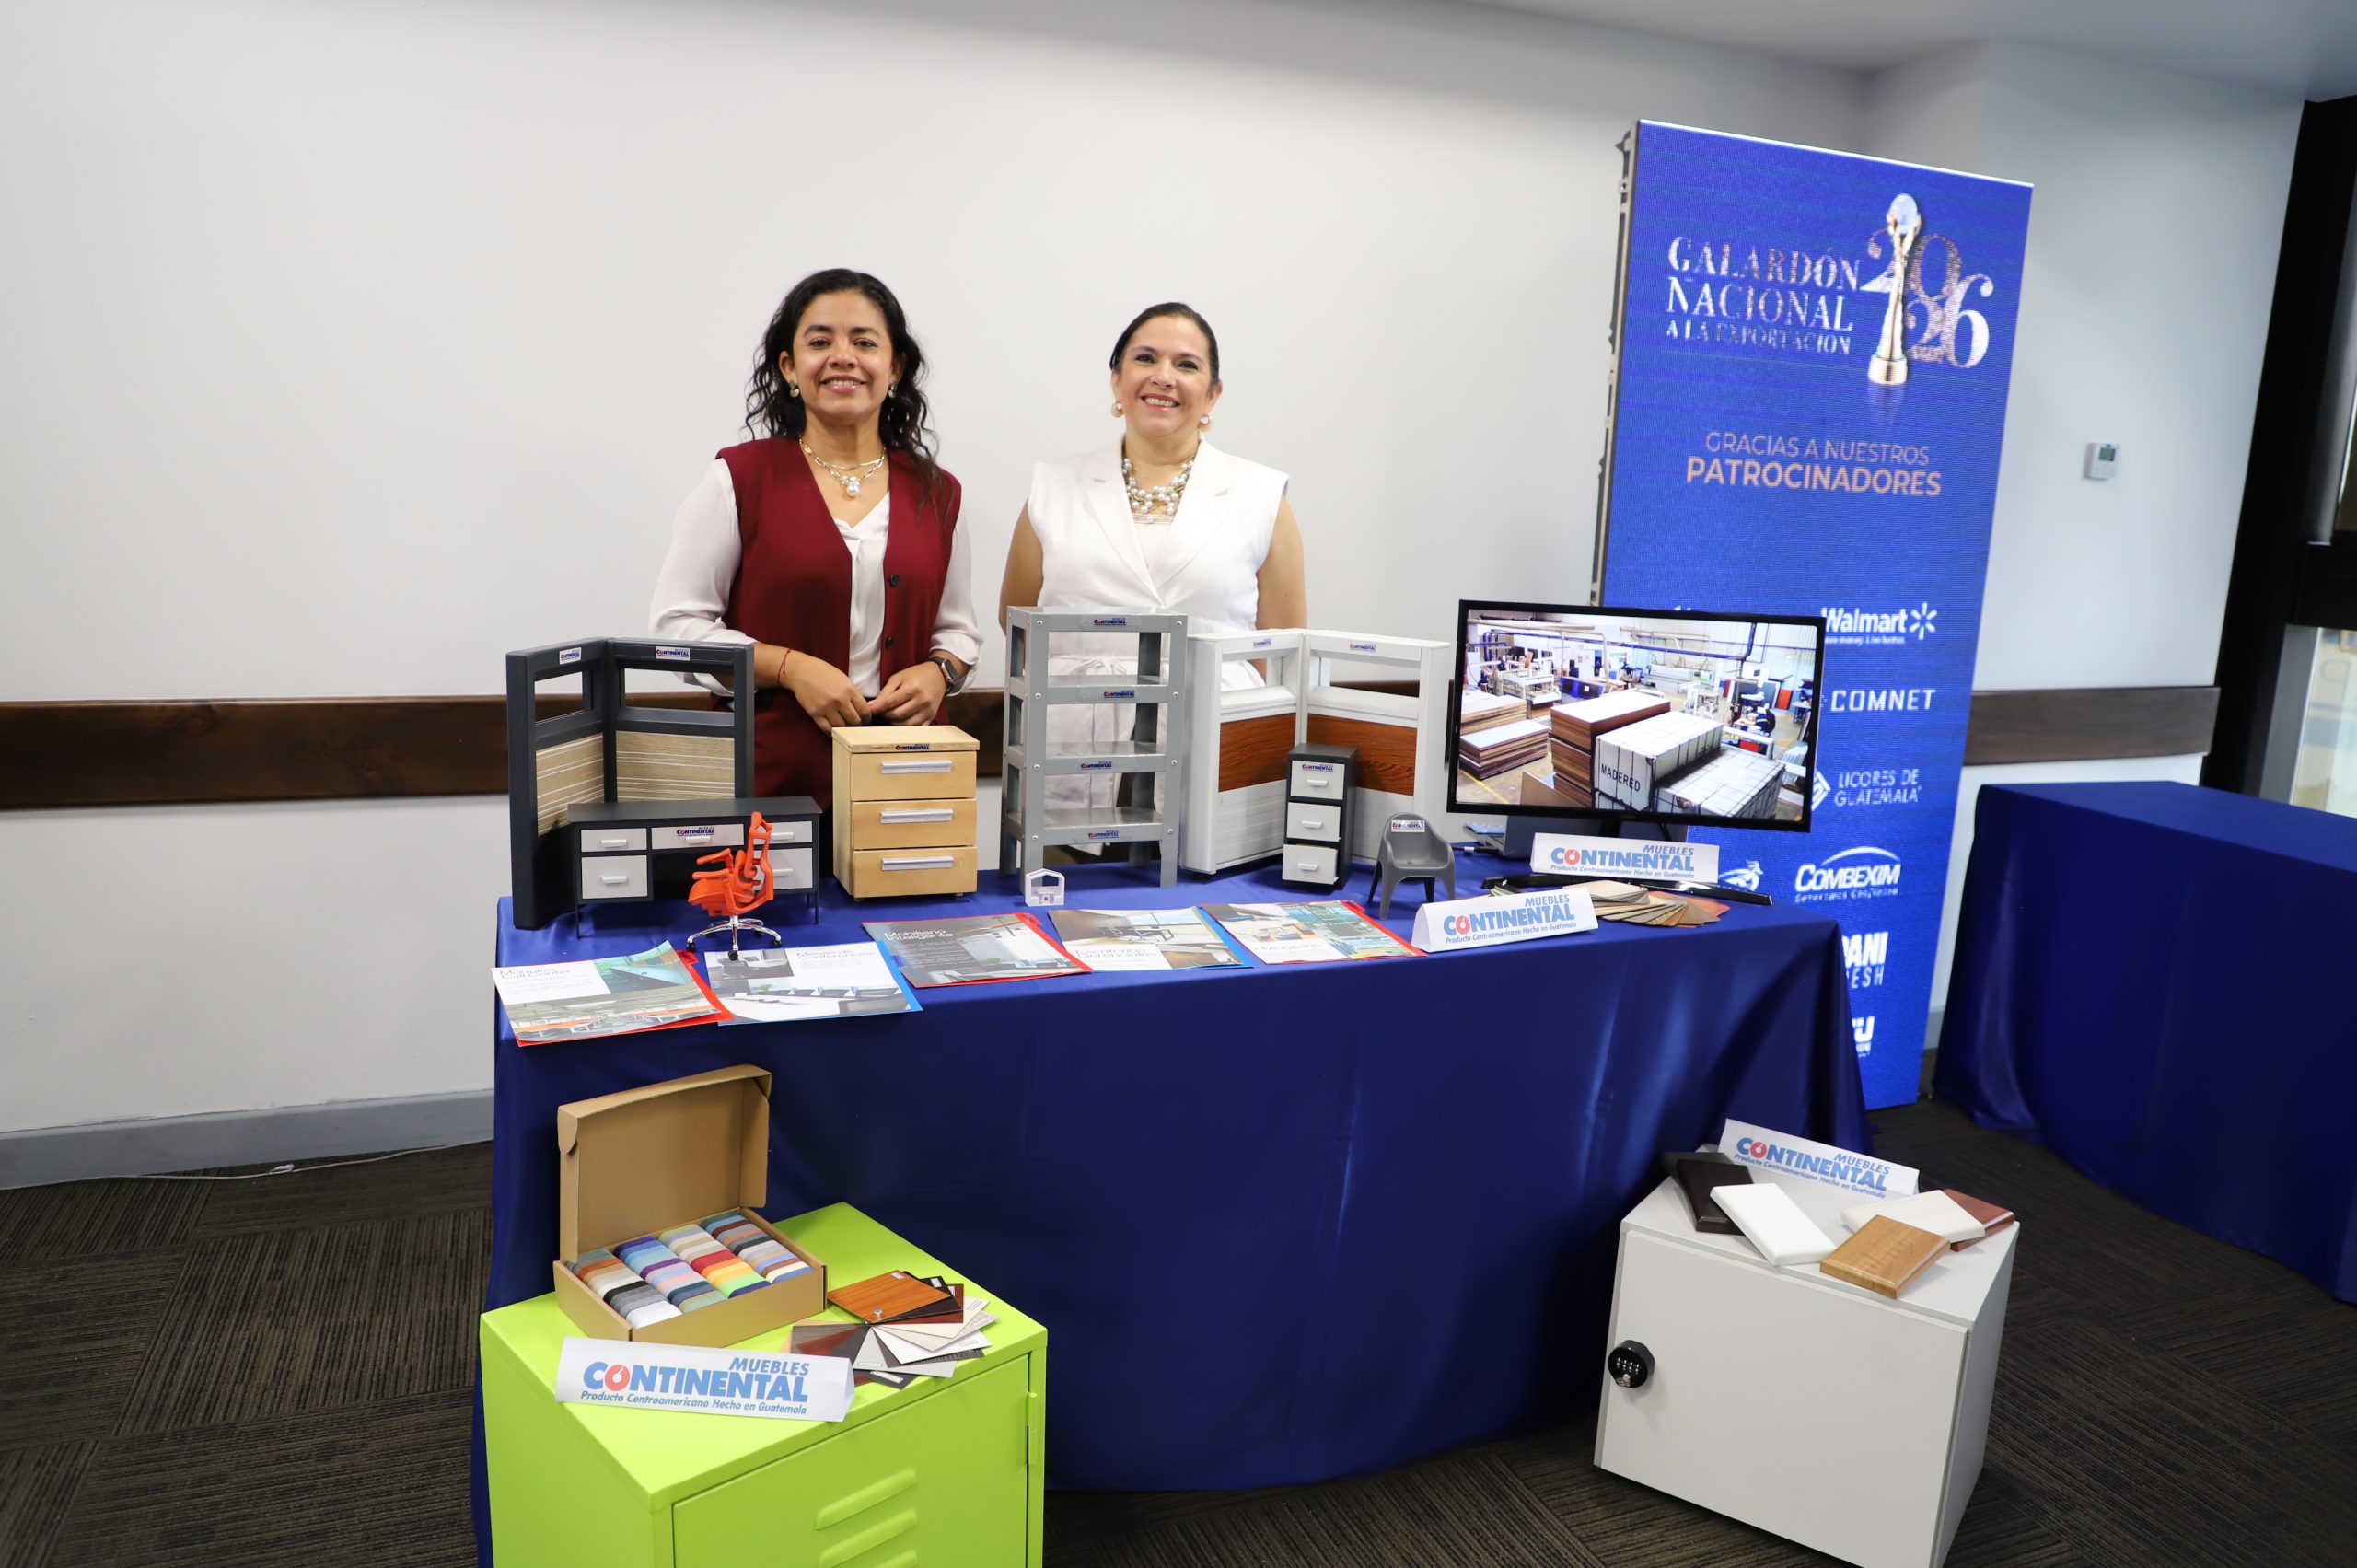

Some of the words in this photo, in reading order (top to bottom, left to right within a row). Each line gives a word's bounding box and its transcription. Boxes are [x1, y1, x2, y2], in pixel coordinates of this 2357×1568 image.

[1667, 236, 1860, 291] GALARDÓN
[1666, 276, 1854, 331] NACIONAL
[1705, 430, 1799, 458] GRACIAS
[1804, 438, 1819, 459] A
[1824, 439, 1931, 466] NUESTROS
[1686, 455, 1942, 496] PATROCINADORES
[1821, 607, 1909, 633] Walmart
[1830, 689, 1937, 712] COMNET
[1601, 763, 1641, 792] MADERED
[1838, 770, 1896, 789] LICORES
[1901, 768, 1920, 785] DE
[1550, 846, 1695, 872] CONTINENTAL
[1643, 844, 1695, 856] MUEBLES
[1550, 864, 1578, 872] Producto
[1579, 865, 1632, 875] Centroamericano
[1663, 870, 1695, 878] Guatemala
[1525, 893, 1571, 908] MUEBLES
[1443, 903, 1575, 936] CONTINENTAL
[1446, 934, 1471, 945] Producto
[1472, 929, 1522, 941] Centroamericano
[1522, 924, 1540, 934] Hecho
[1549, 921, 1577, 931] Guatemala
[1734, 1154, 1762, 1167] Producto
[1763, 1161, 1818, 1182] Centroamericano
[1819, 1176, 1840, 1188] Hecho
[1851, 1184, 1887, 1200] Guatemala
[1736, 1137, 1887, 1191] CONTINENTAL
[1834, 1153, 1890, 1176] MUEBLES
[728, 1357, 810, 1376] MUEBLES
[583, 1361, 808, 1403] CONTINENTAL
[581, 1390, 624, 1402] Producto
[627, 1393, 710, 1409] Centroamericano
[712, 1399, 742, 1411] Hecho
[743, 1402, 756, 1411] en
[758, 1401, 807, 1415] Guatemala
